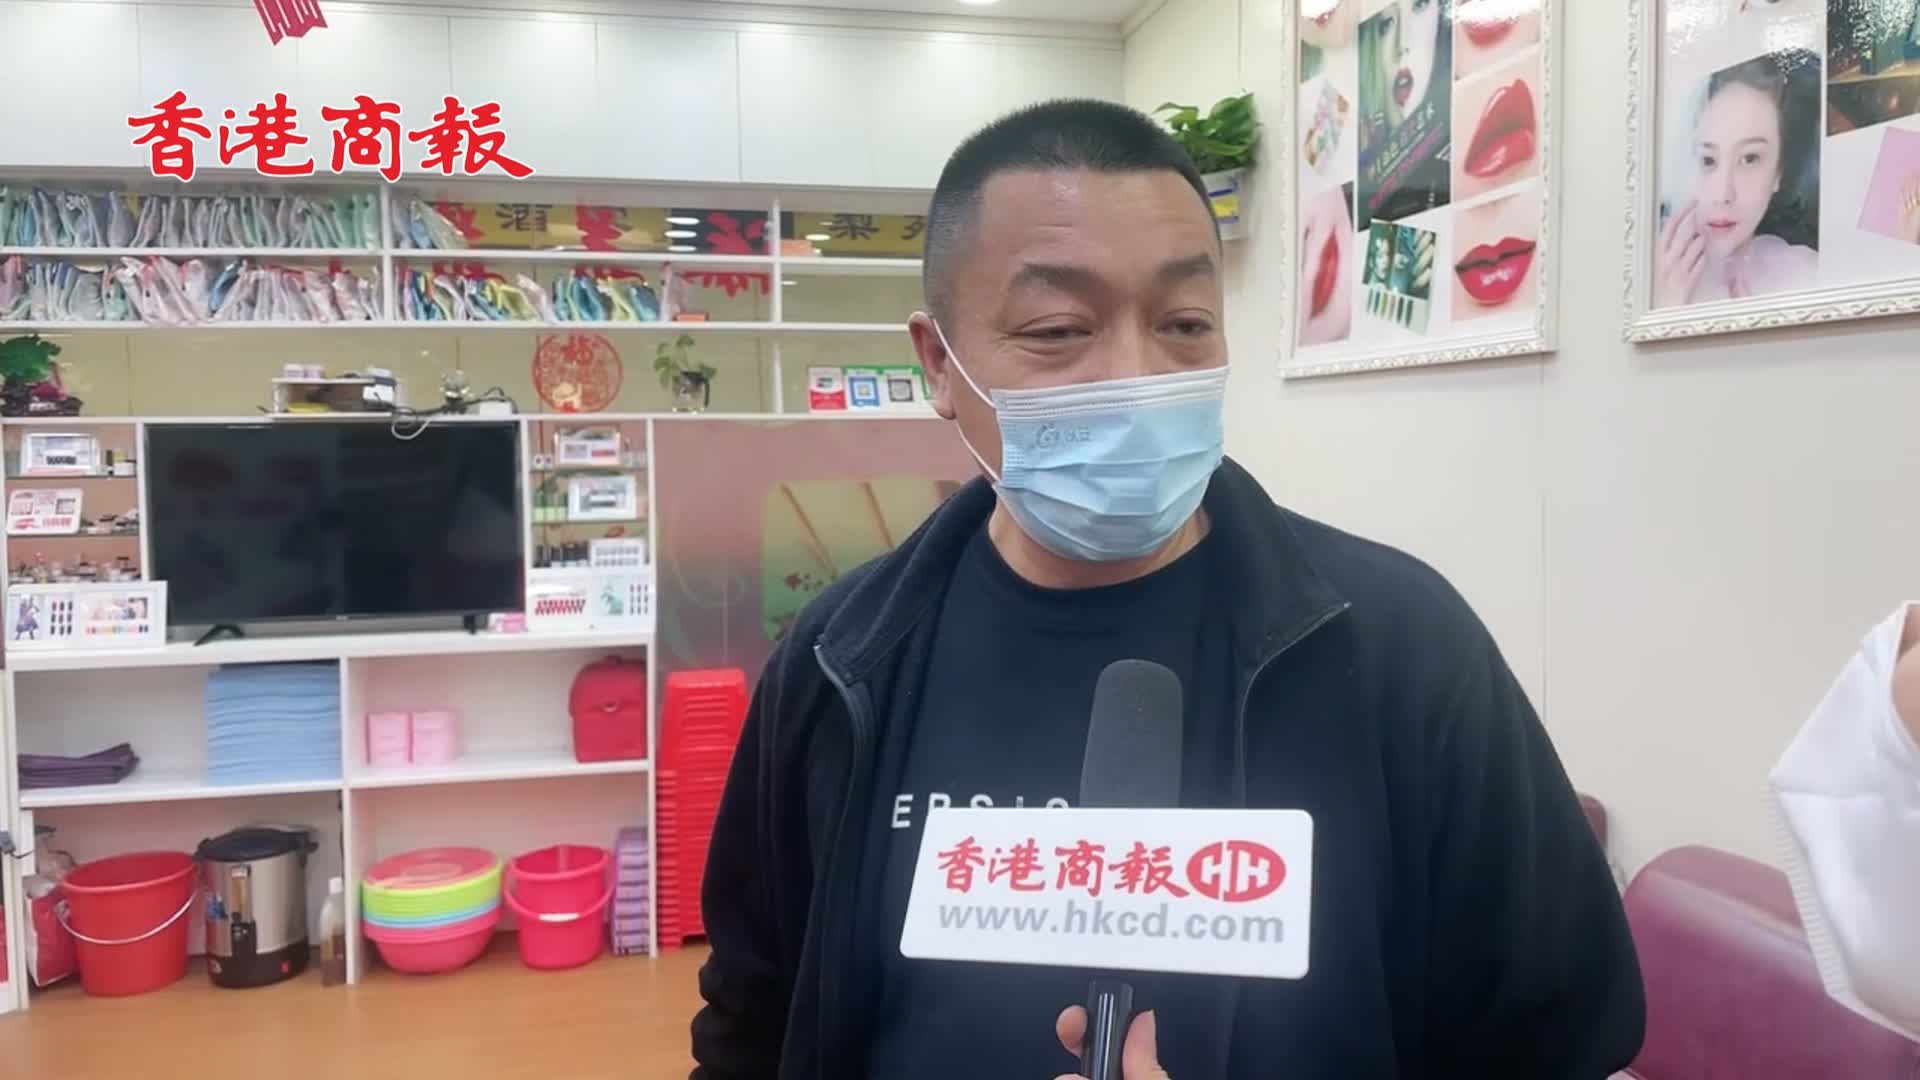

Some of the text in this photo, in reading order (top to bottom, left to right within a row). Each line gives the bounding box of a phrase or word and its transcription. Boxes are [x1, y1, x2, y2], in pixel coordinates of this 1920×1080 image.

[937, 836, 1190, 899] 香港商報
[938, 899, 1285, 943] www.hkcd.com
